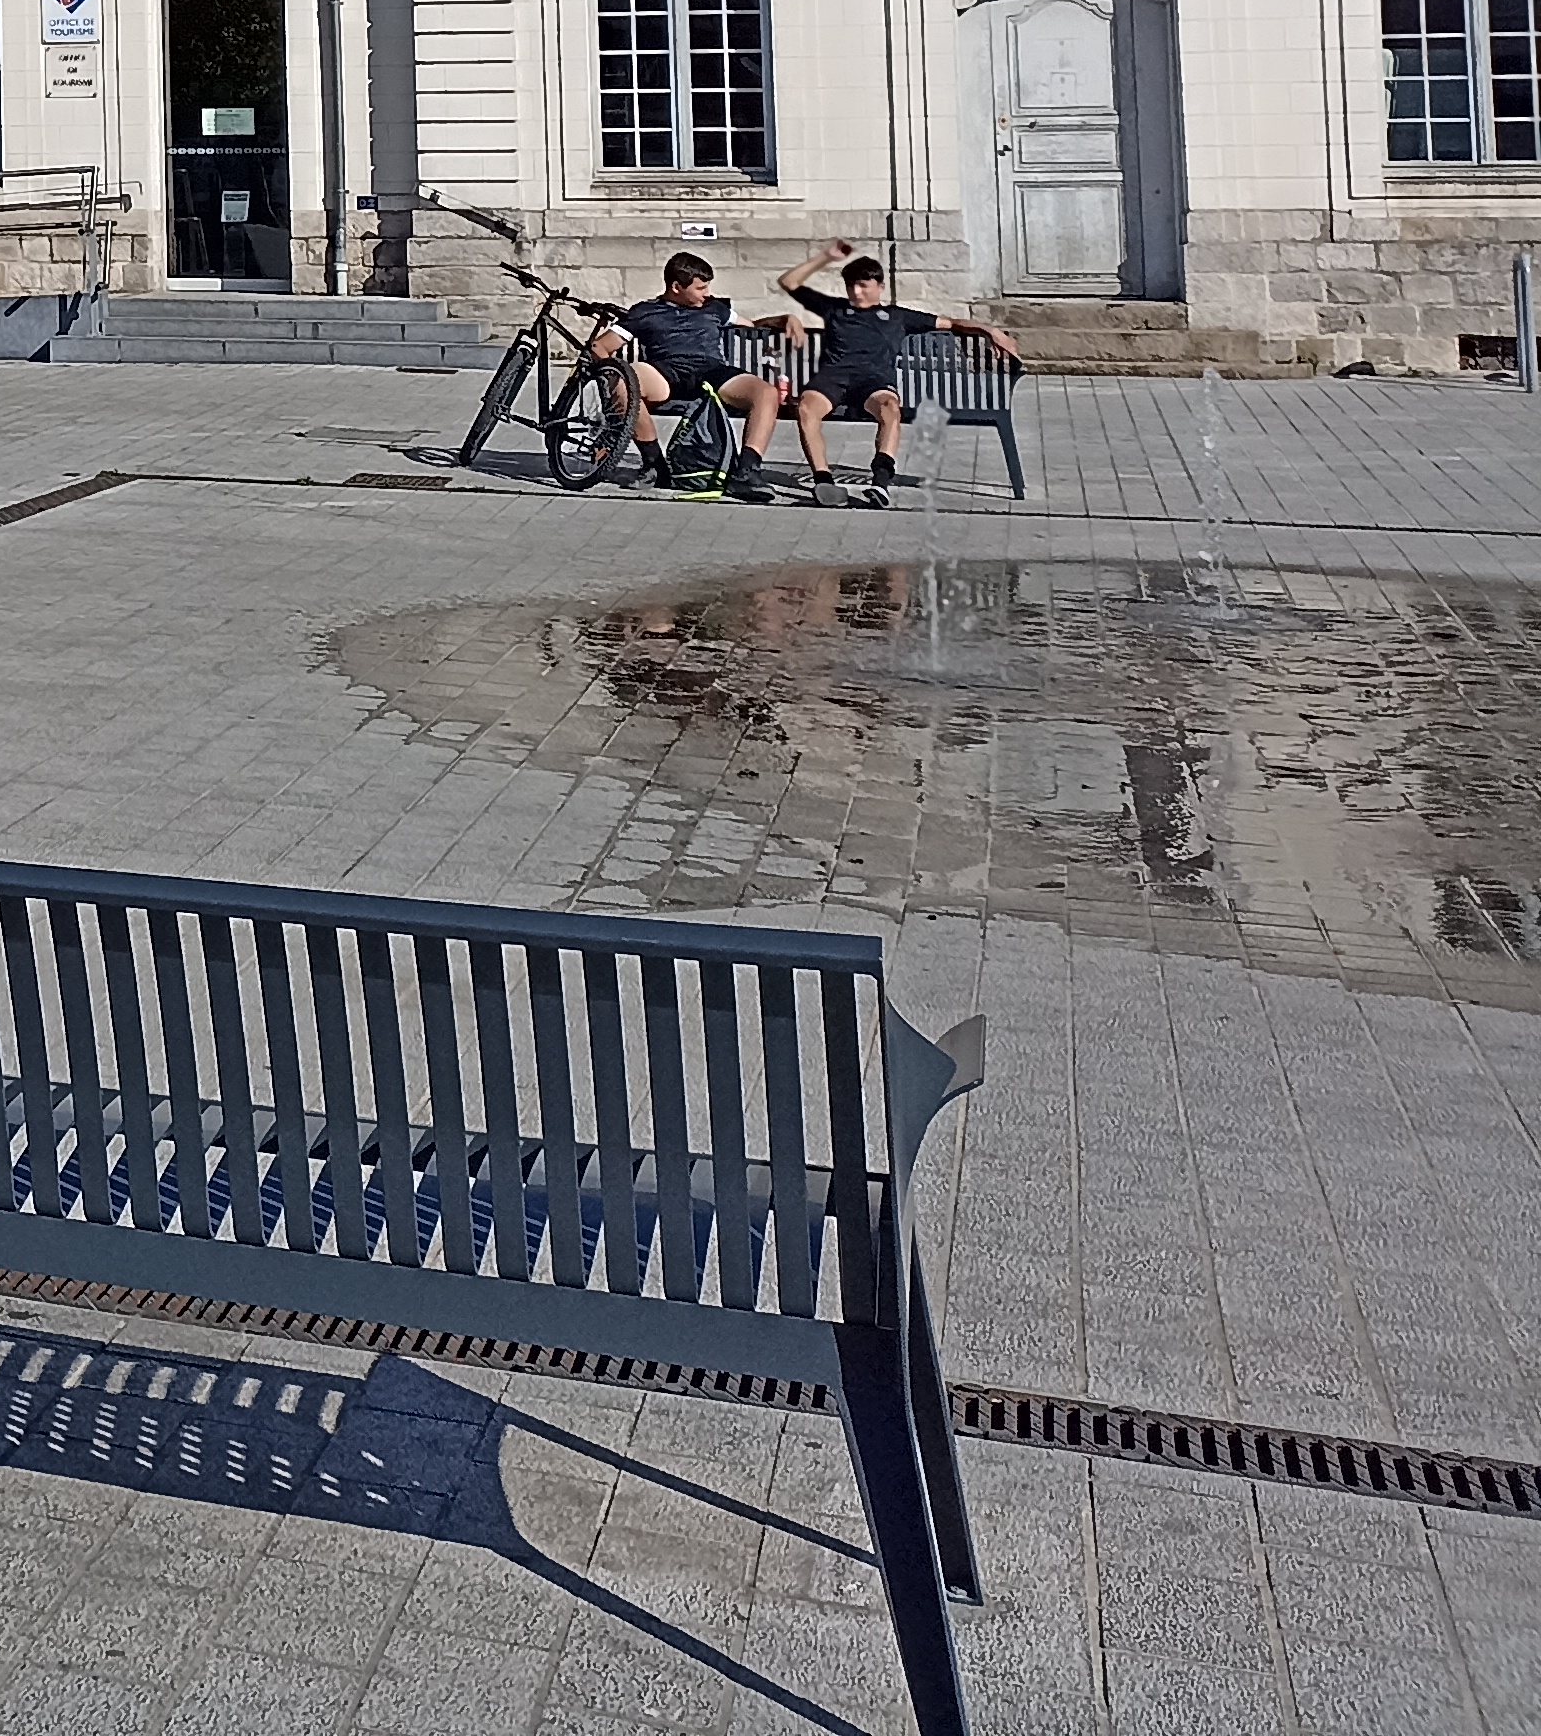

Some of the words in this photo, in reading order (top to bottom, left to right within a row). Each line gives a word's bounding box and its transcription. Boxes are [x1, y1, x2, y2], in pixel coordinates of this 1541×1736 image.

[49, 18, 79, 26] OFFICE
[83, 18, 95, 26] DE
[50, 28, 95, 36] TOURISME
